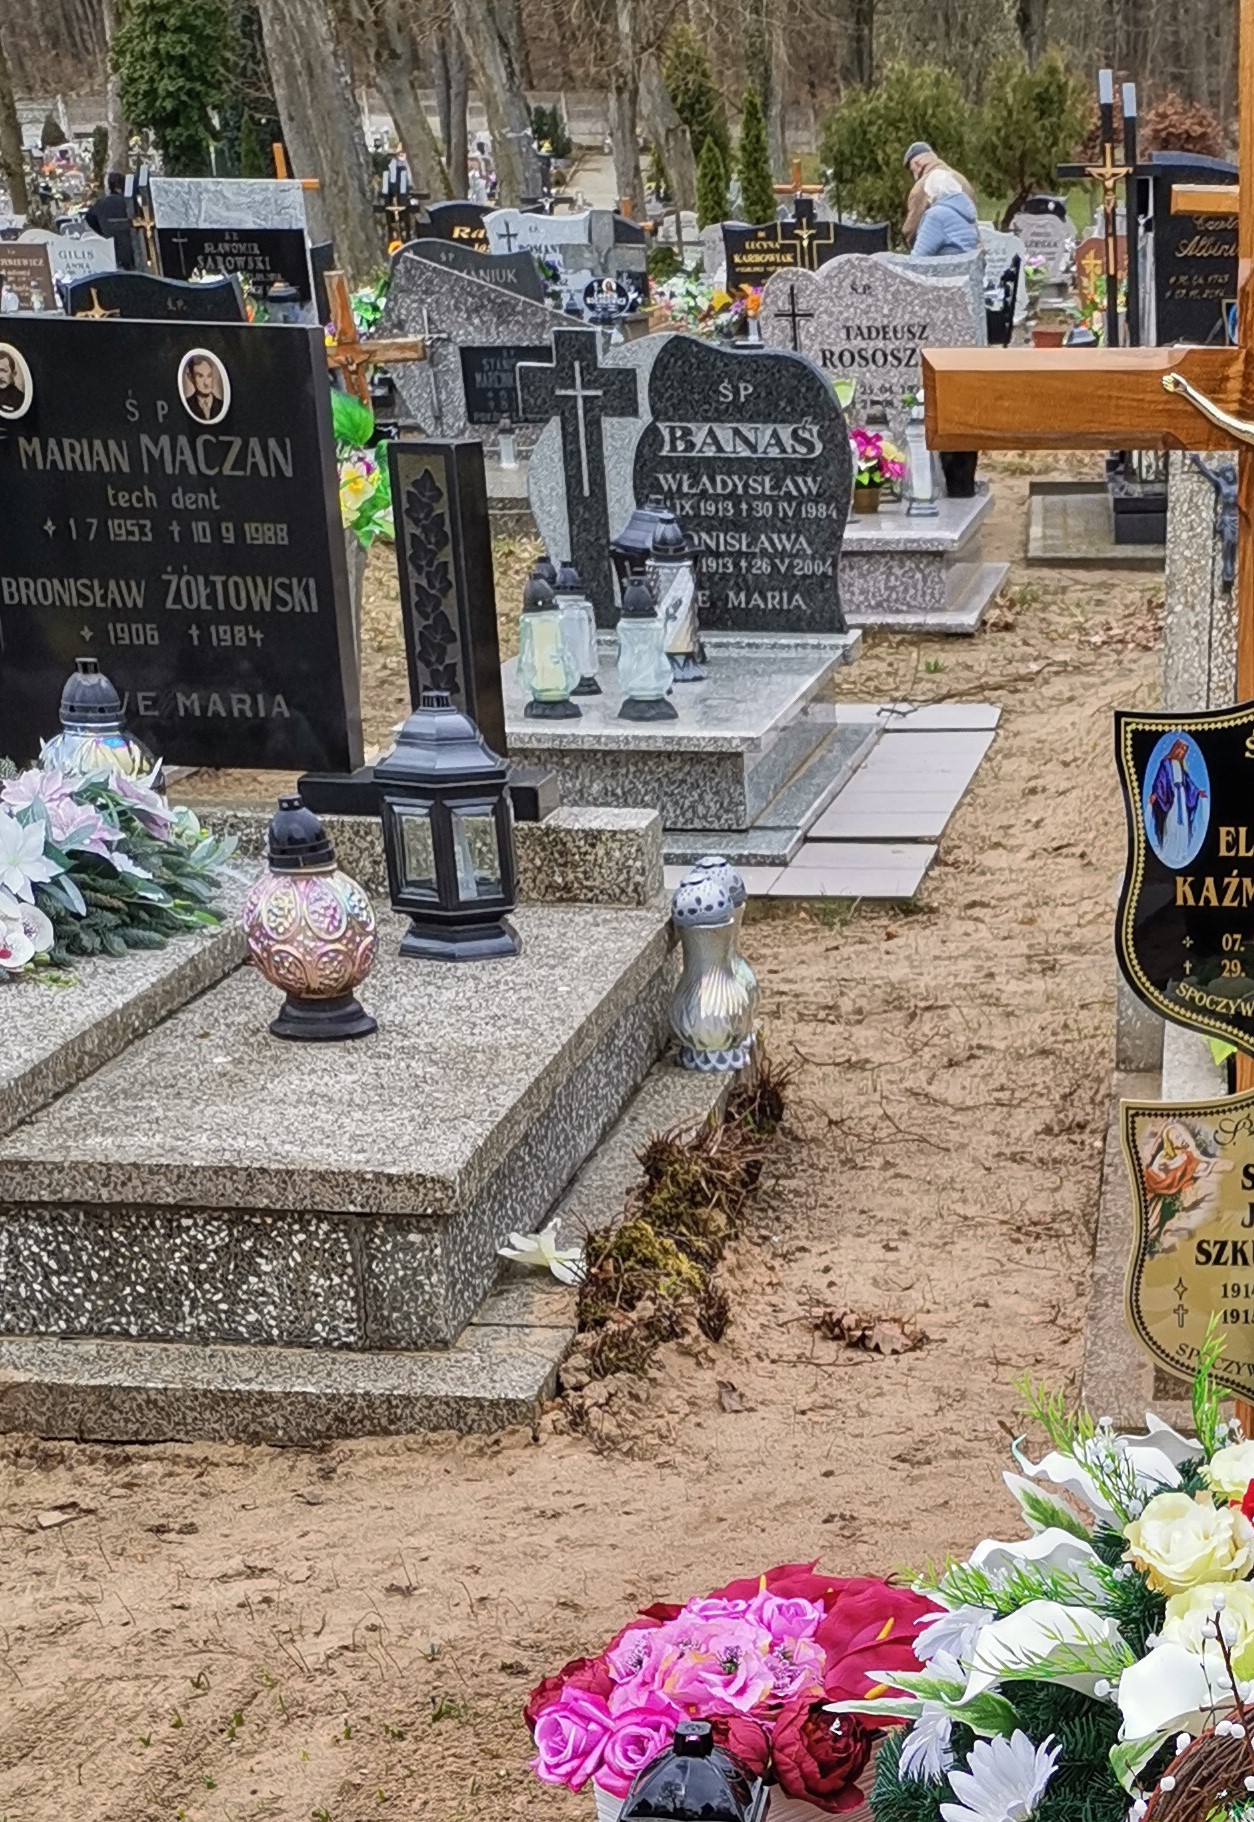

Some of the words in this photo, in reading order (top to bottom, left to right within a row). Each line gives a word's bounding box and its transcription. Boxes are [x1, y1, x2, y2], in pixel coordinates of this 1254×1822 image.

[842, 322, 929, 341] TADEUSZ
[664, 416, 823, 457] BANAŚ
[18, 435, 131, 474] MARIAN
[139, 433, 294, 477] MACZAN
[107, 484, 158, 508] tech
[171, 487, 221, 510] dent
[656, 473, 823, 497] WŁADYSŁAW
[700, 501, 735, 517] 1913
[779, 502, 799, 518] IV
[801, 502, 838, 519] 1984
[84, 519, 98, 541] 7
[108, 519, 153, 542] 1953
[192, 521, 212, 543] 10
[221, 522, 235, 544] 9
[244, 523, 289, 545] 1988
[690, 531, 812, 554] NISŁAWA
[702, 556, 734, 575] 1913
[776, 557, 793, 575] V
[794, 557, 834, 576] 2004
[1, 576, 146, 609] BRONISŁAW
[161, 564, 319, 613] ŻÓŁTOWSKI
[727, 590, 808, 610] MARIA
[108, 623, 160, 645] 1906
[210, 624, 265, 647] 1984
[177, 691, 291, 718] MARIA
[1221, 933, 1246, 952] 07.
[1220, 959, 1246, 978] 29.
